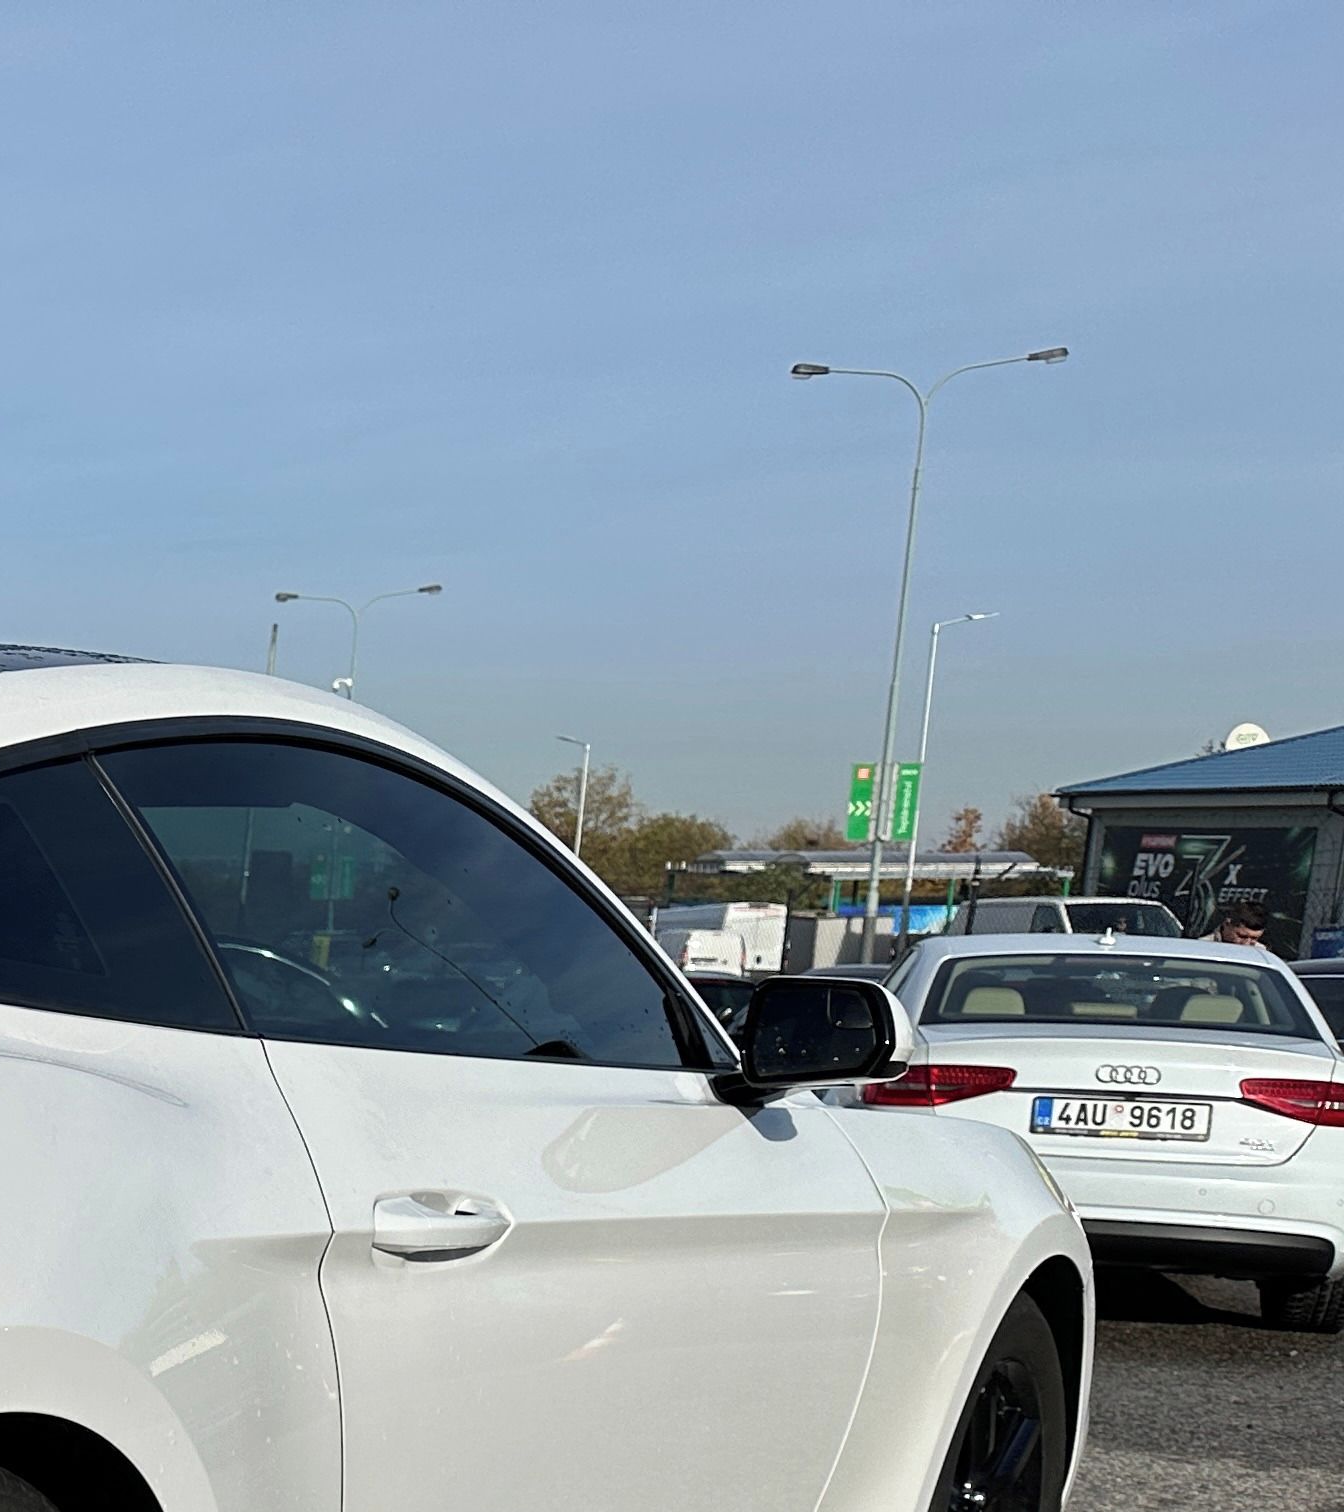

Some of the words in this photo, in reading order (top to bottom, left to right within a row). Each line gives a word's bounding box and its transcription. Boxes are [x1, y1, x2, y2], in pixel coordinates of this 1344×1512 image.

[1133, 853, 1175, 878] EVO
[1058, 1102, 1108, 1126] 4AU
[1129, 1105, 1196, 1130] 9618
